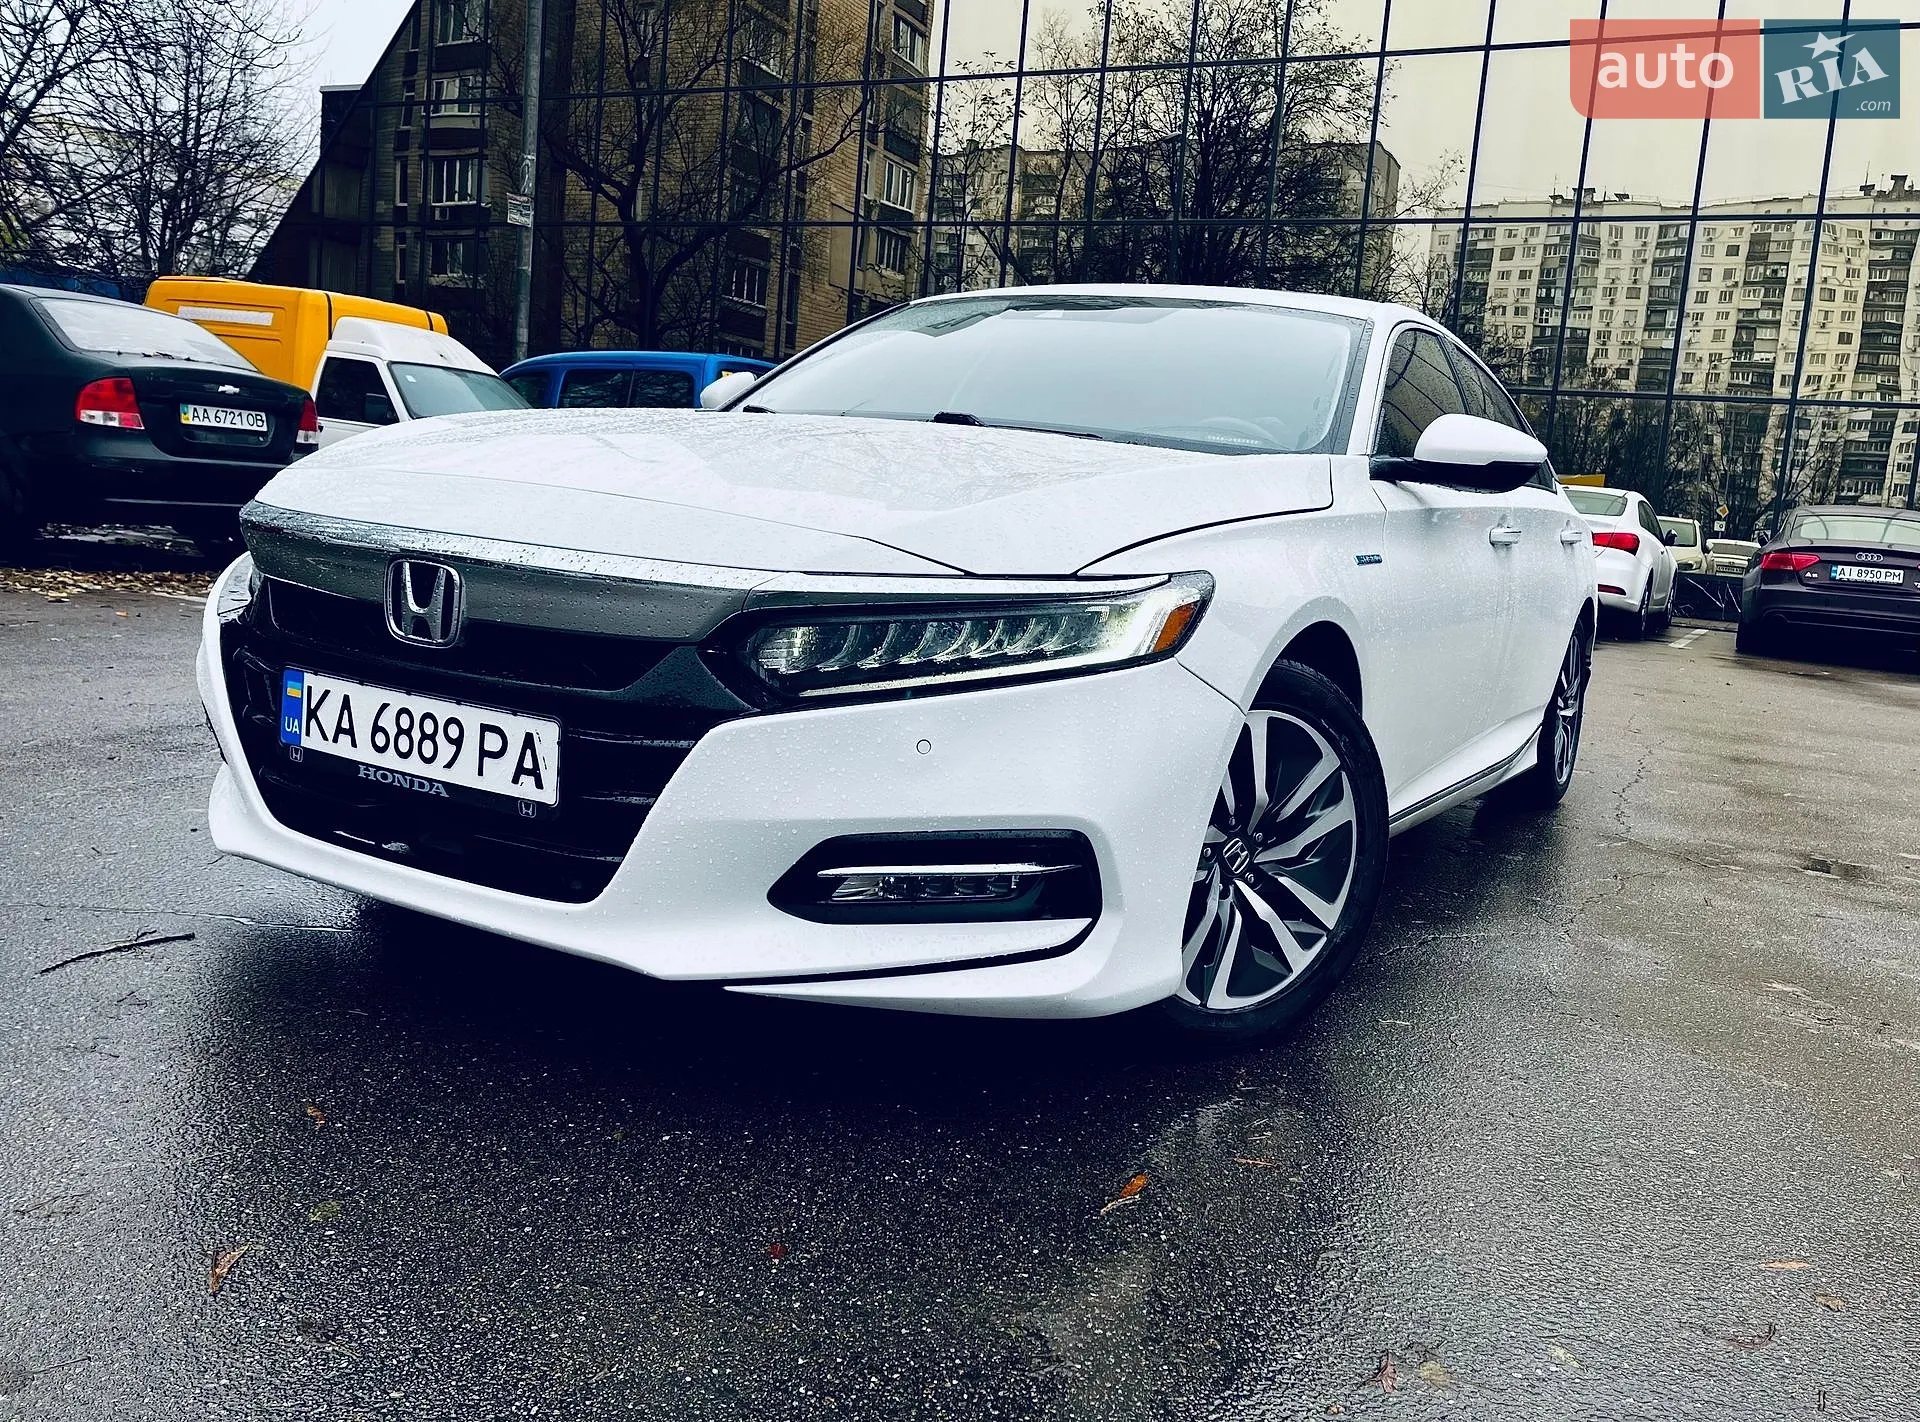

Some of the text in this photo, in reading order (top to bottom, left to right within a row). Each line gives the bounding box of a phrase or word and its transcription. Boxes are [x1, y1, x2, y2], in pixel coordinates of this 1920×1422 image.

[192, 407, 211, 423] AA
[214, 409, 243, 426] 6721
[246, 412, 265, 428] OB
[1838, 567, 1901, 581] AI 8950 PM
[284, 716, 300, 734] UA
[304, 685, 544, 790] KA 6889 PA
[357, 764, 450, 798] HONDA
